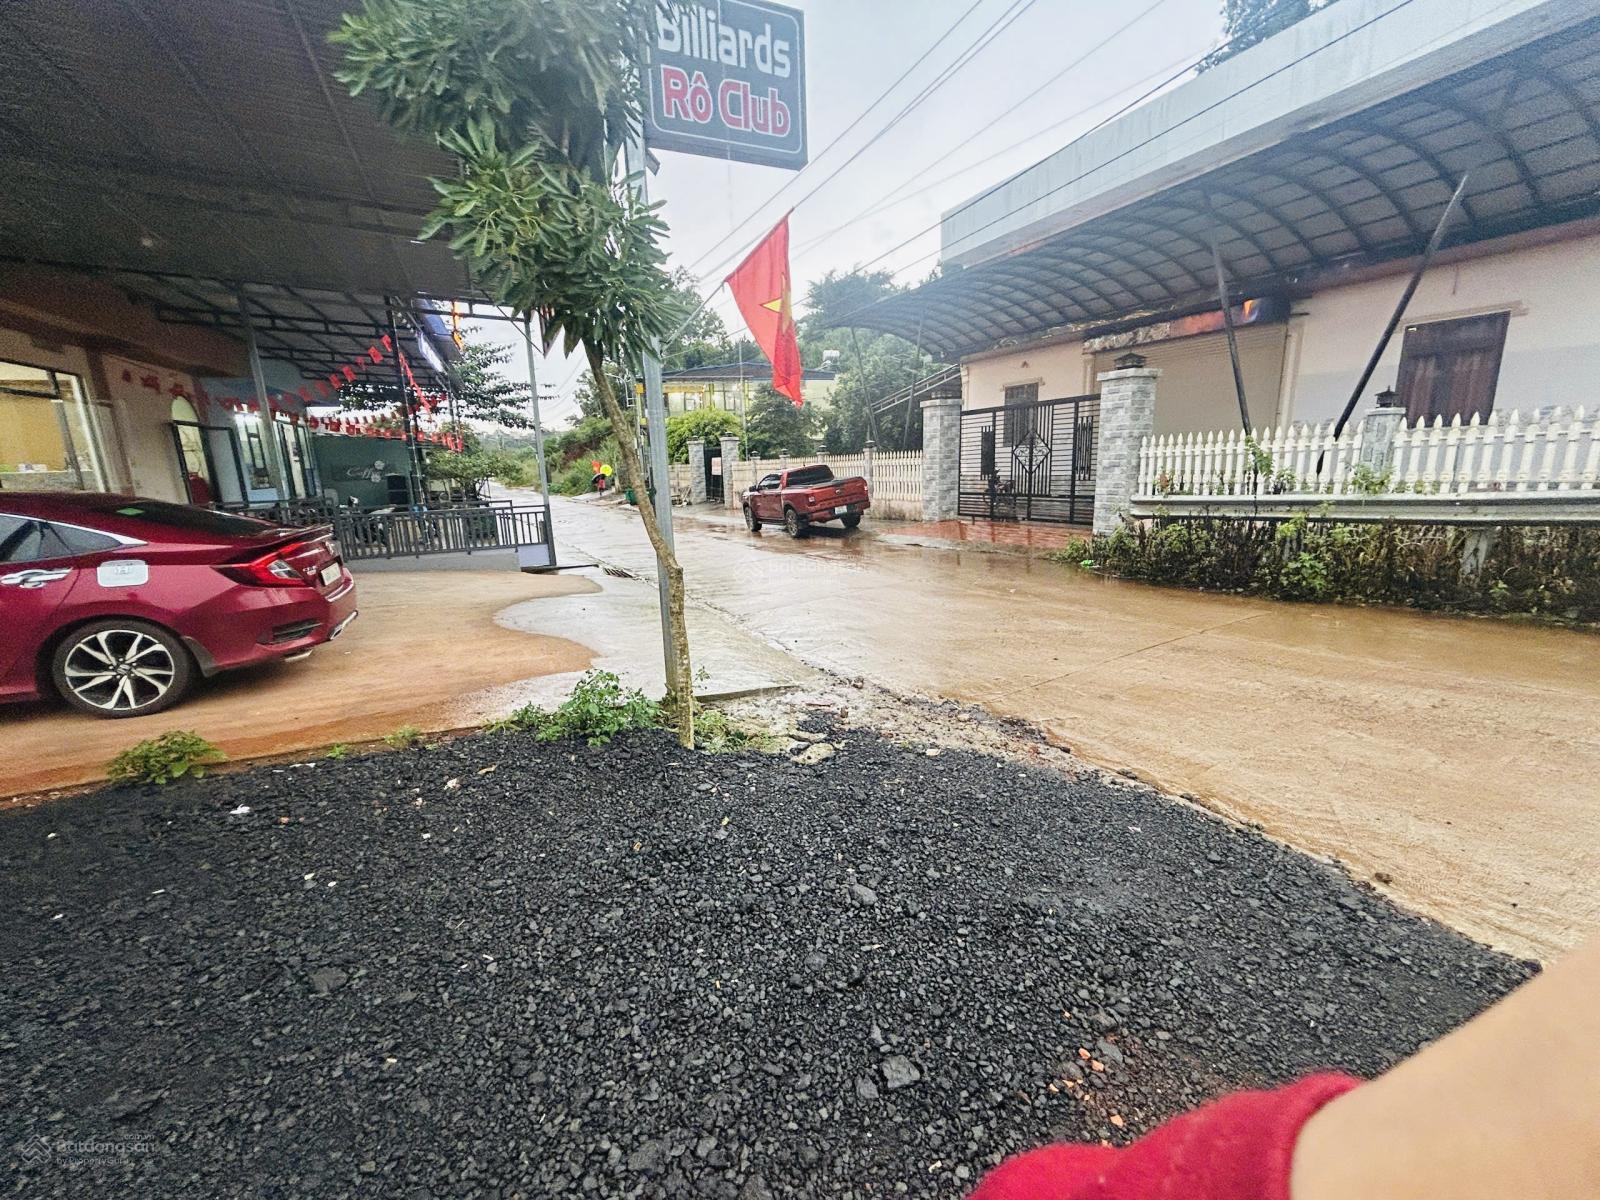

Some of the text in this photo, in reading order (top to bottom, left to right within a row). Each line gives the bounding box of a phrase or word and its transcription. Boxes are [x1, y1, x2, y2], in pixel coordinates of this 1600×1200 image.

[655, 3, 791, 78] Billiards
[661, 64, 791, 137] Rô Club
